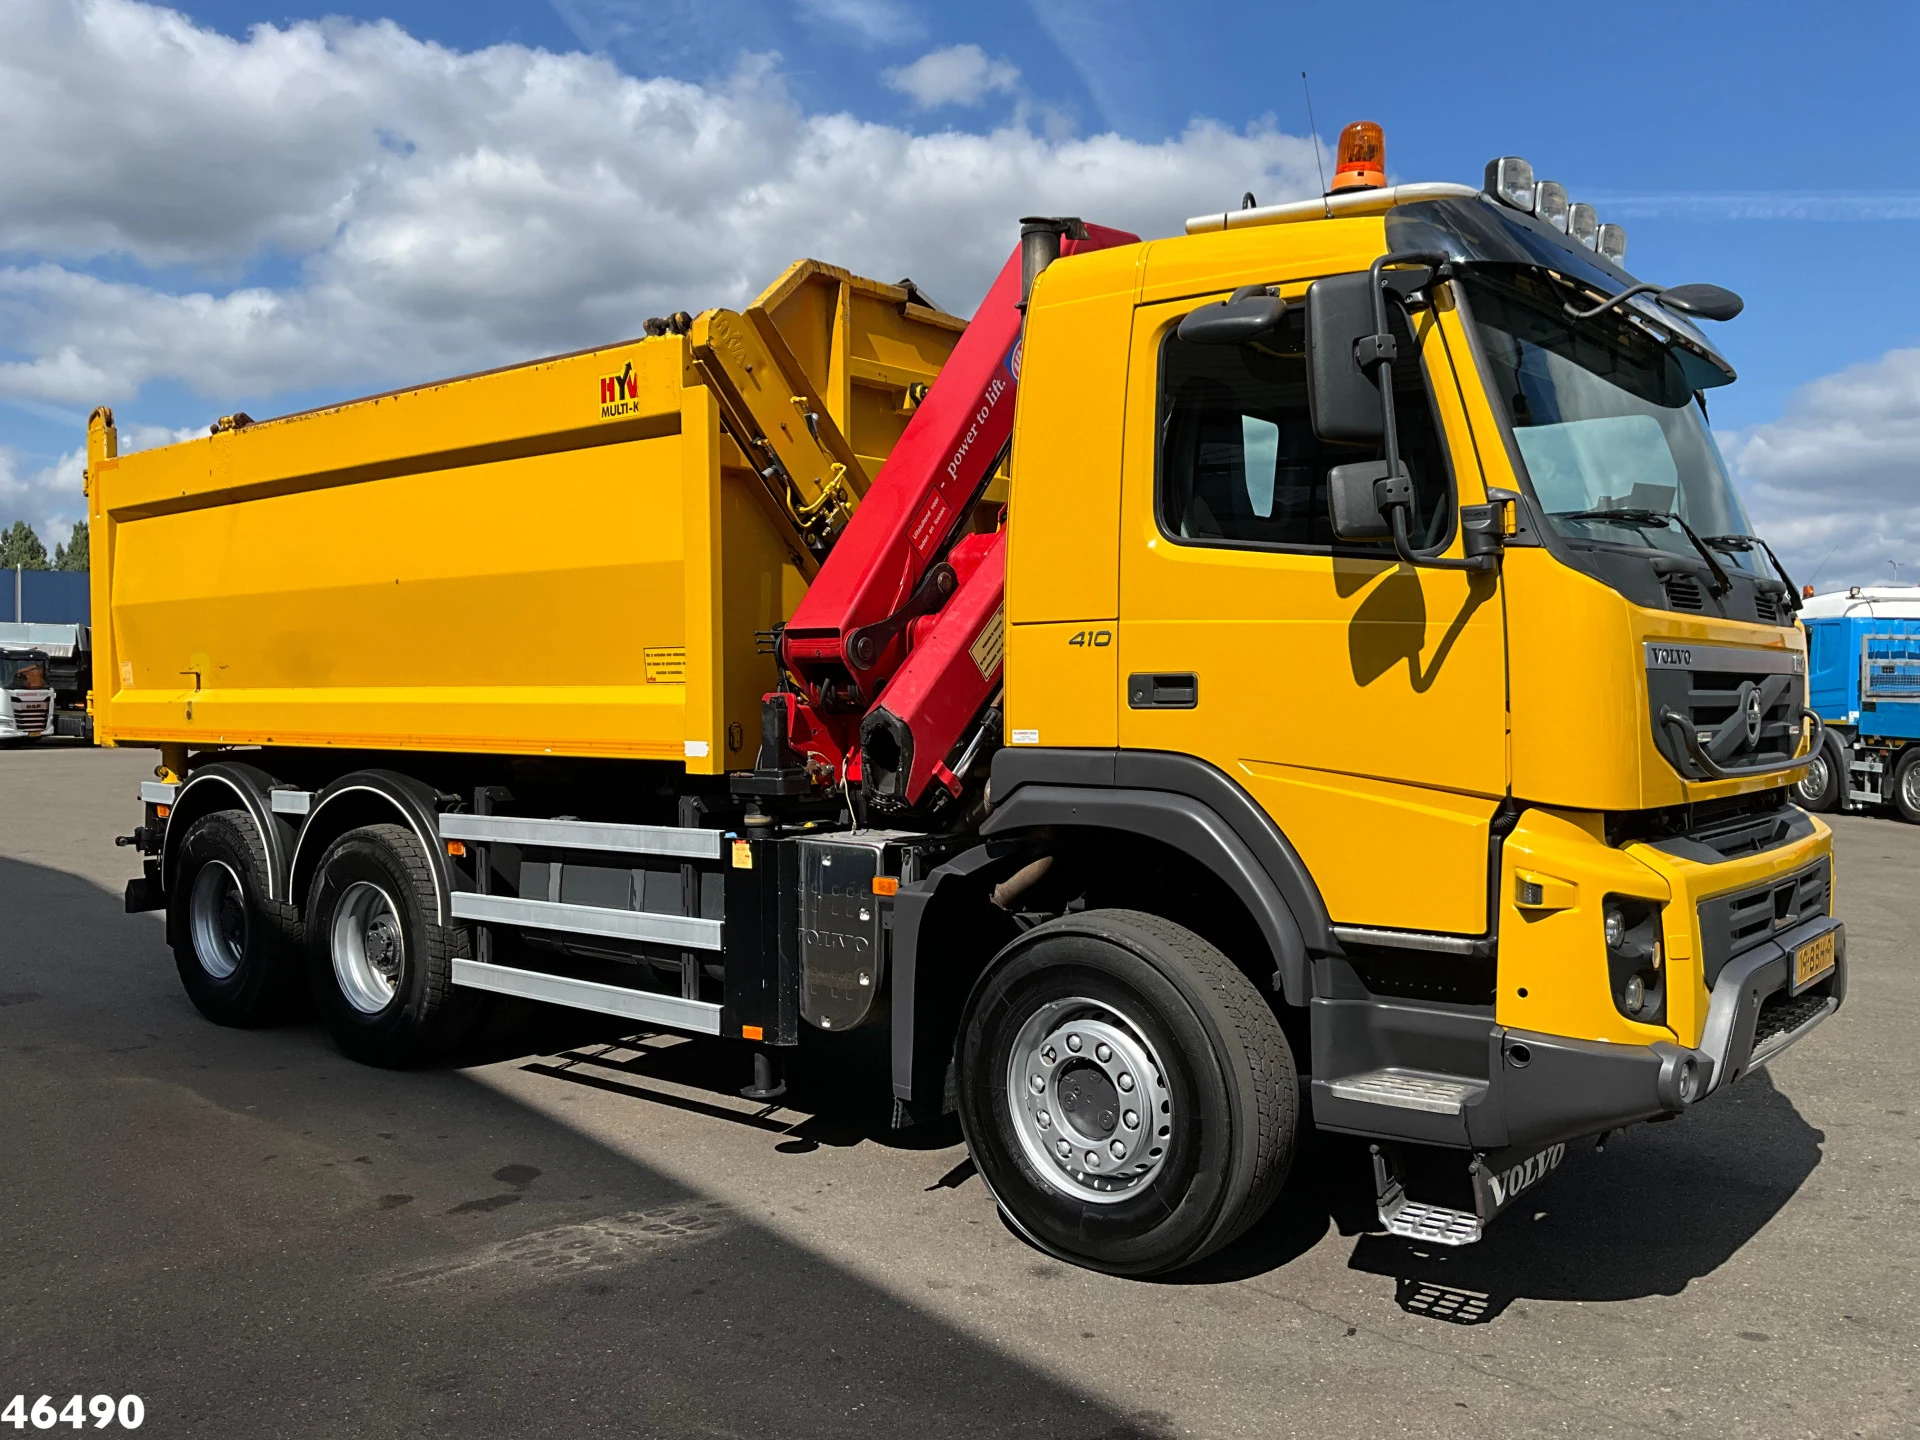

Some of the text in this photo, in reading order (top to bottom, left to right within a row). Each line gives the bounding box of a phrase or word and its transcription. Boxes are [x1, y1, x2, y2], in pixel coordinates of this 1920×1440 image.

[947, 423, 979, 481] power
[976, 405, 990, 425] to
[984, 379, 1006, 407] lift.
[1068, 630, 1112, 647] 410
[1651, 647, 1692, 666] VOLVO
[1487, 1142, 1566, 1207] VOLVO
